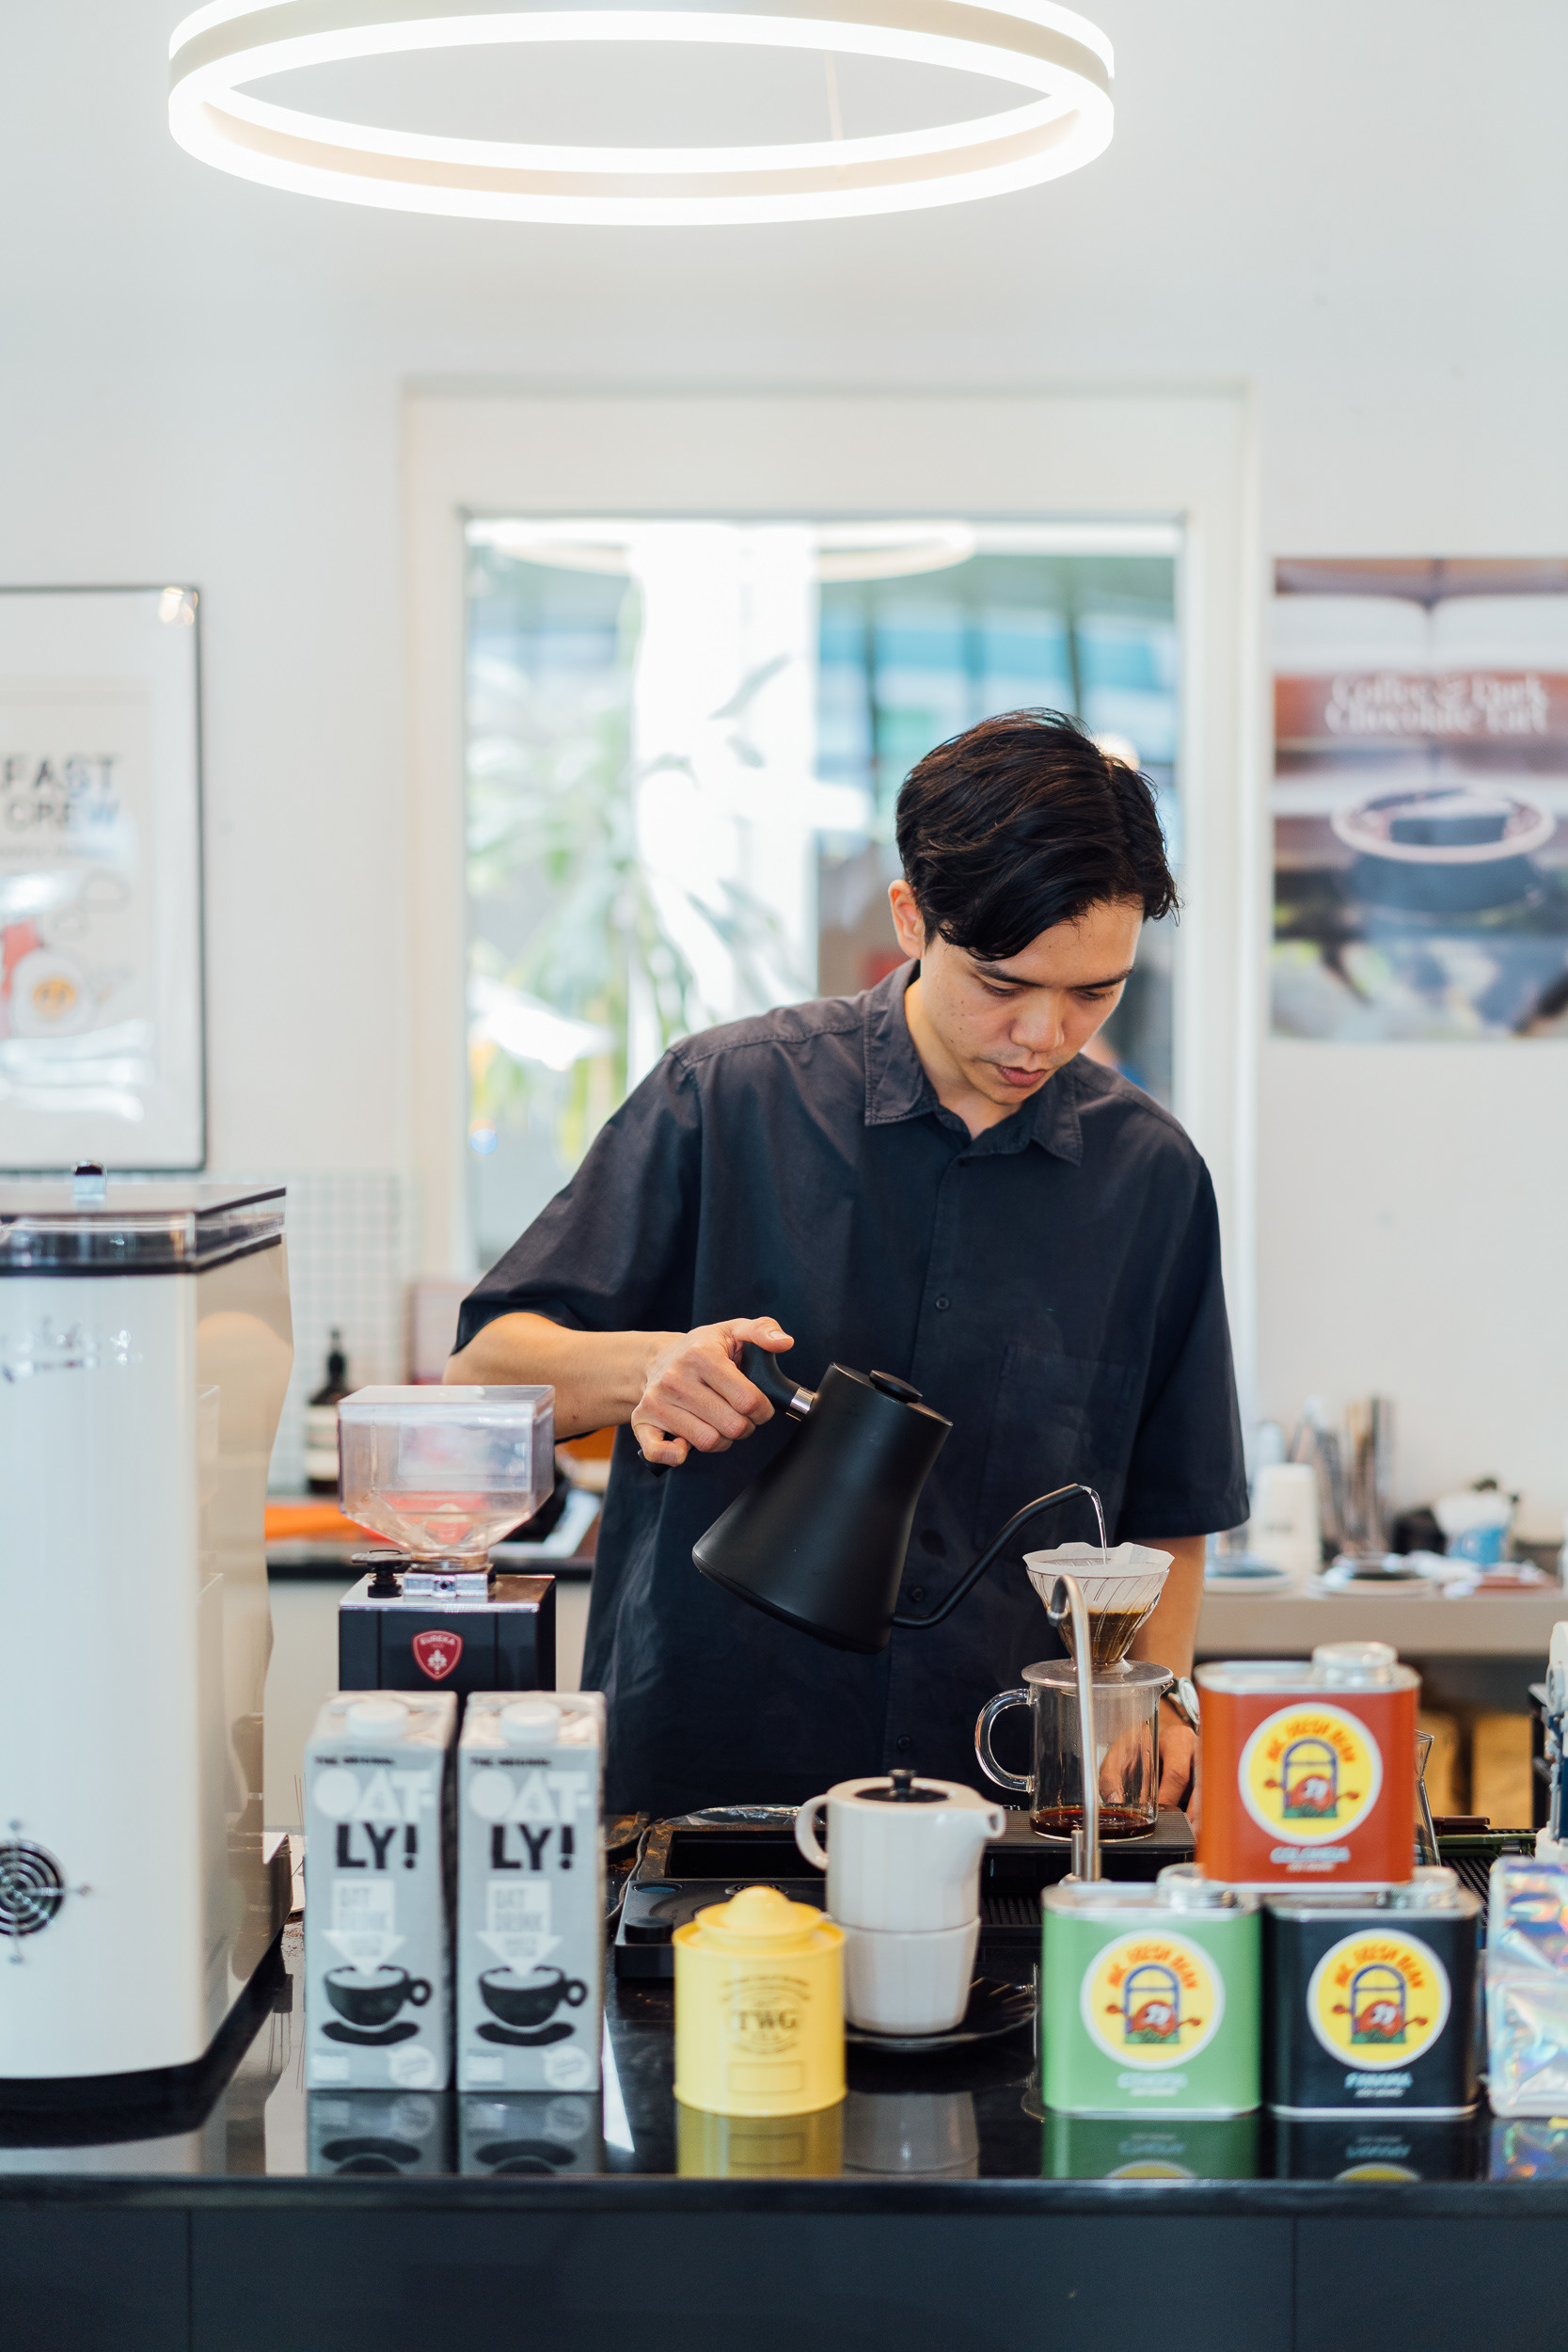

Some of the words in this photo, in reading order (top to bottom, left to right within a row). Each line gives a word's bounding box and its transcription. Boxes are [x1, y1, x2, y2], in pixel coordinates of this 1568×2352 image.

[1471, 672, 1550, 709] Dark
[1324, 700, 1479, 735] Chocolate
[0, 753, 119, 798] FAST
[336, 1821, 418, 1870] LY!
[491, 1822, 574, 1871] LY!
[737, 2010, 798, 2030] TWG
